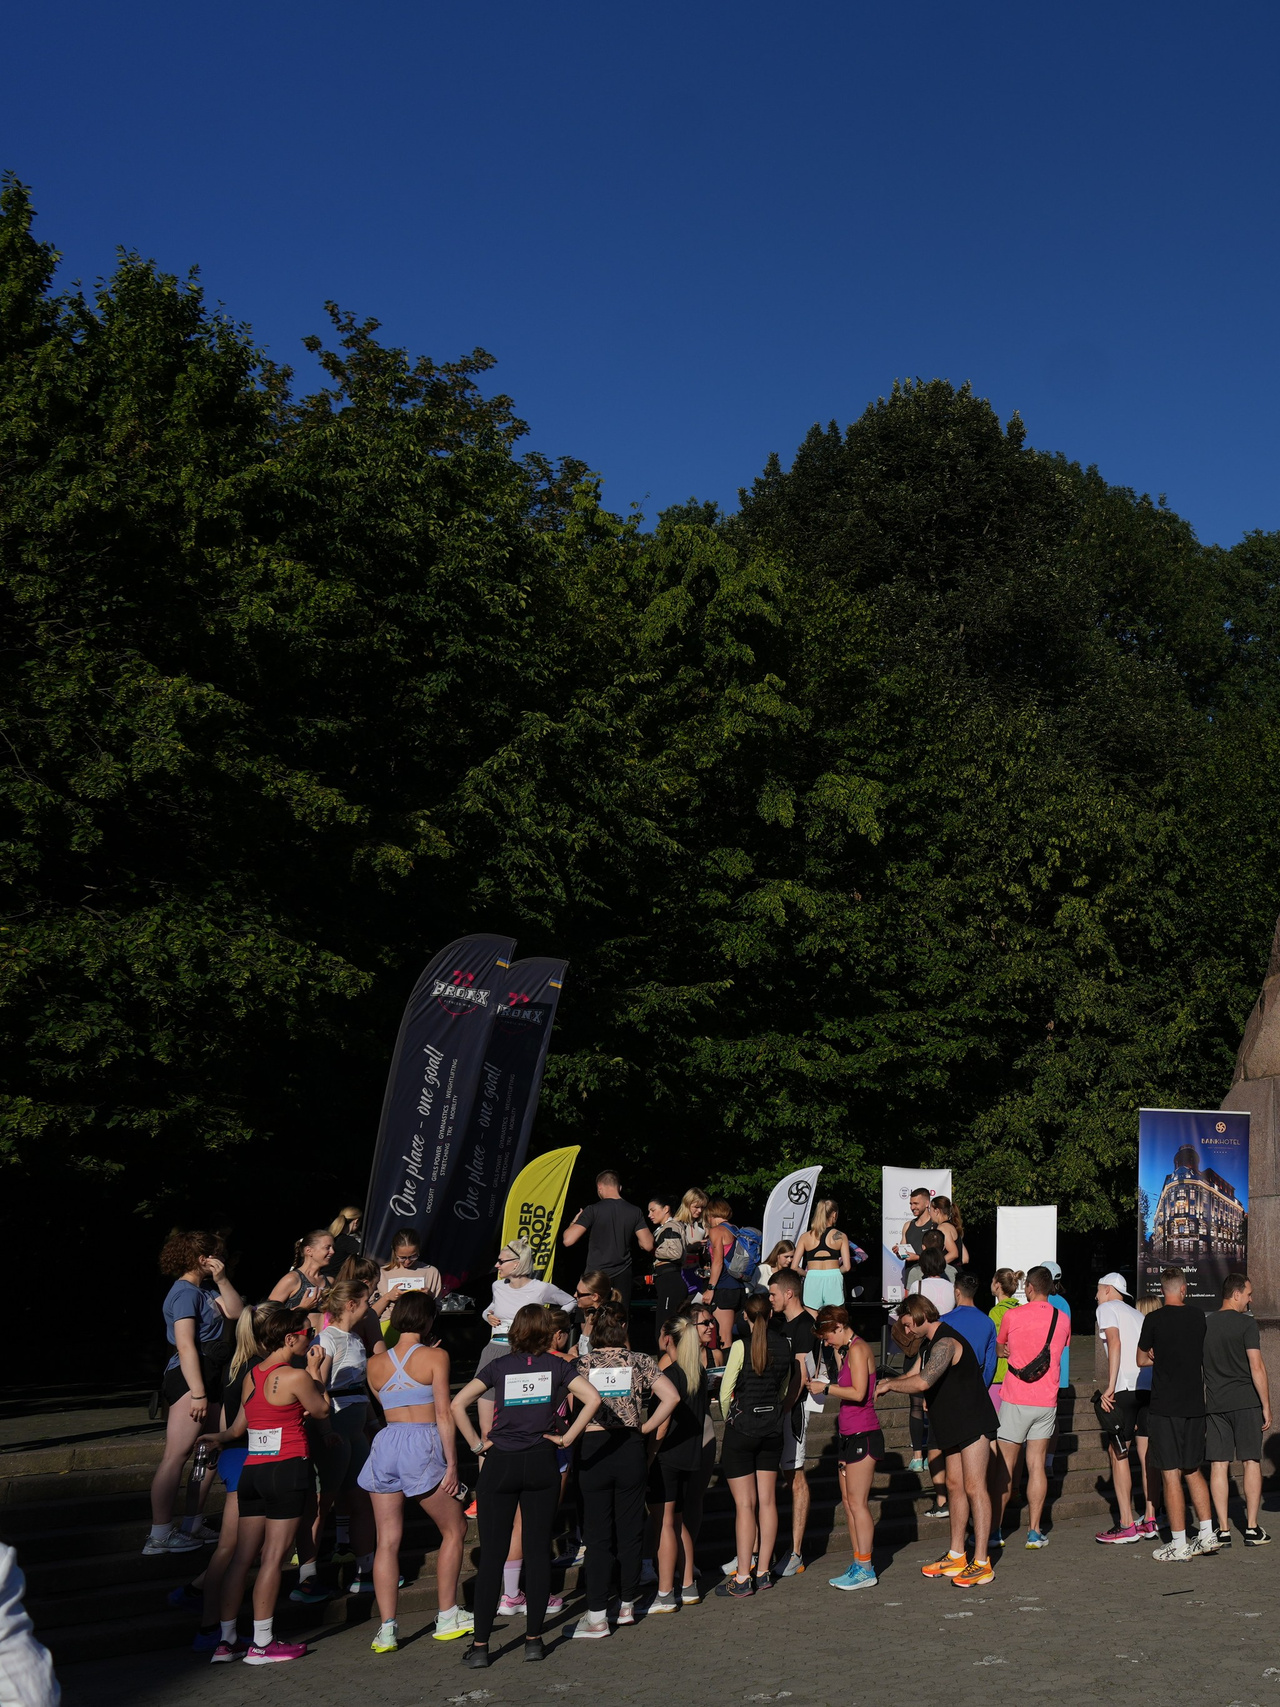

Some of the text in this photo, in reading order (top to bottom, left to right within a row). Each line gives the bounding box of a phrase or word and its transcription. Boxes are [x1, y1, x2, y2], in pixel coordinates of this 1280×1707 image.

[430, 979, 490, 1007] BRONX
[423, 1044, 444, 1088] goal!
[484, 1061, 502, 1102] goal!
[416, 1087, 434, 1116] one
[477, 1101, 494, 1128] one
[426, 1058, 458, 1213] CROSSFIT GIRLS POWER GYMNASTICS WEIGHTLIFTING
[440, 1095, 458, 1176] STRETCHING TRX MOBILITY
[402, 1134, 425, 1181] place
[464, 1144, 487, 1187] place
[389, 1180, 417, 1217] One
[453, 1185, 480, 1221] One
[517, 1202, 534, 1240] DER
[782, 1212, 794, 1240] TEL
[522, 1383, 535, 1392] 59
